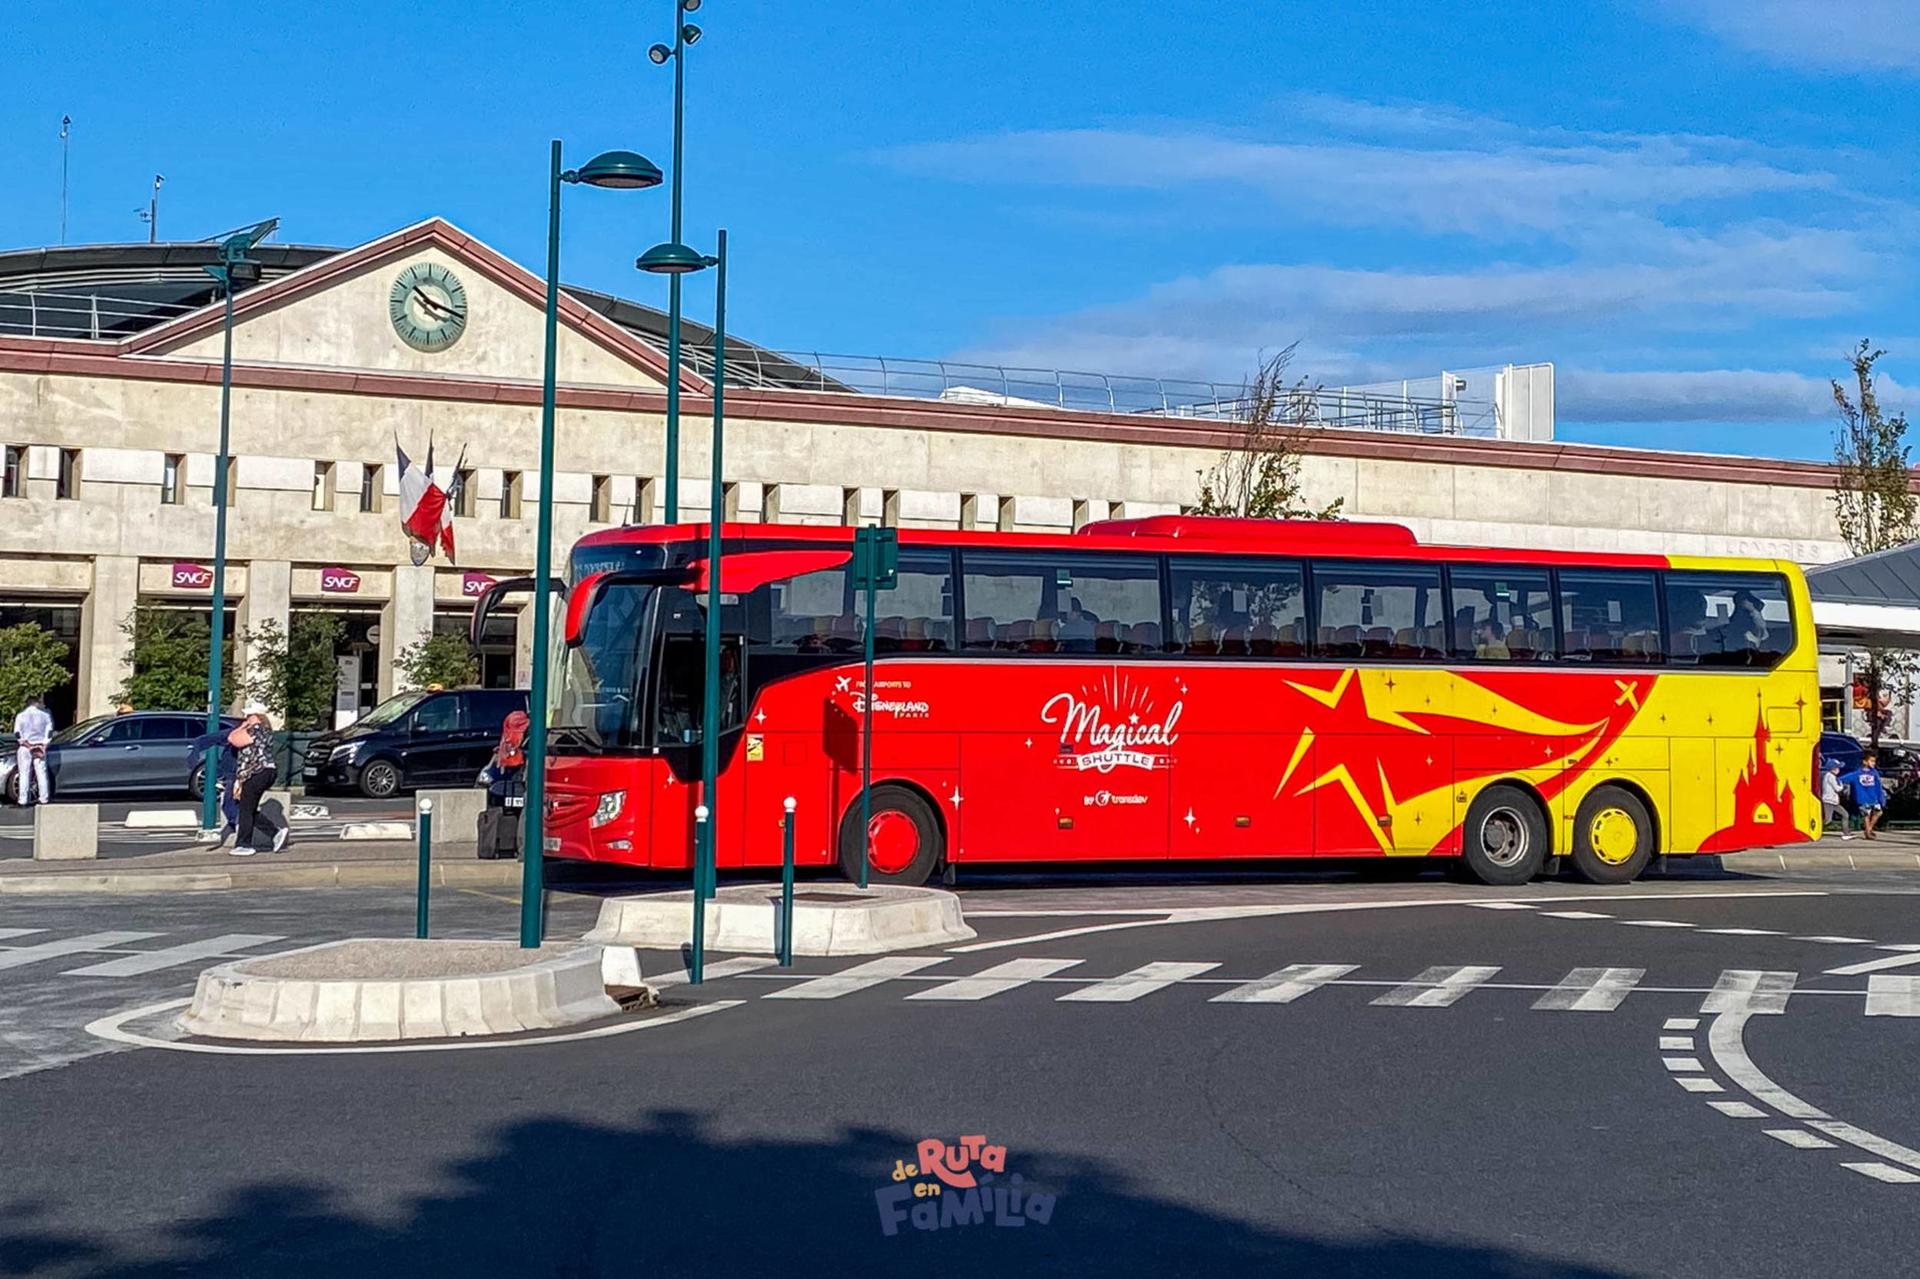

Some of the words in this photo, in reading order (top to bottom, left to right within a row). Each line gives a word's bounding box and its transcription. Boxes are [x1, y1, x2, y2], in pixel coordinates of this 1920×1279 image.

[174, 571, 213, 584] SNCF
[323, 575, 359, 588] SNCF
[1041, 693, 1183, 773] Magical
[1081, 752, 1151, 767] SHUTTLE
